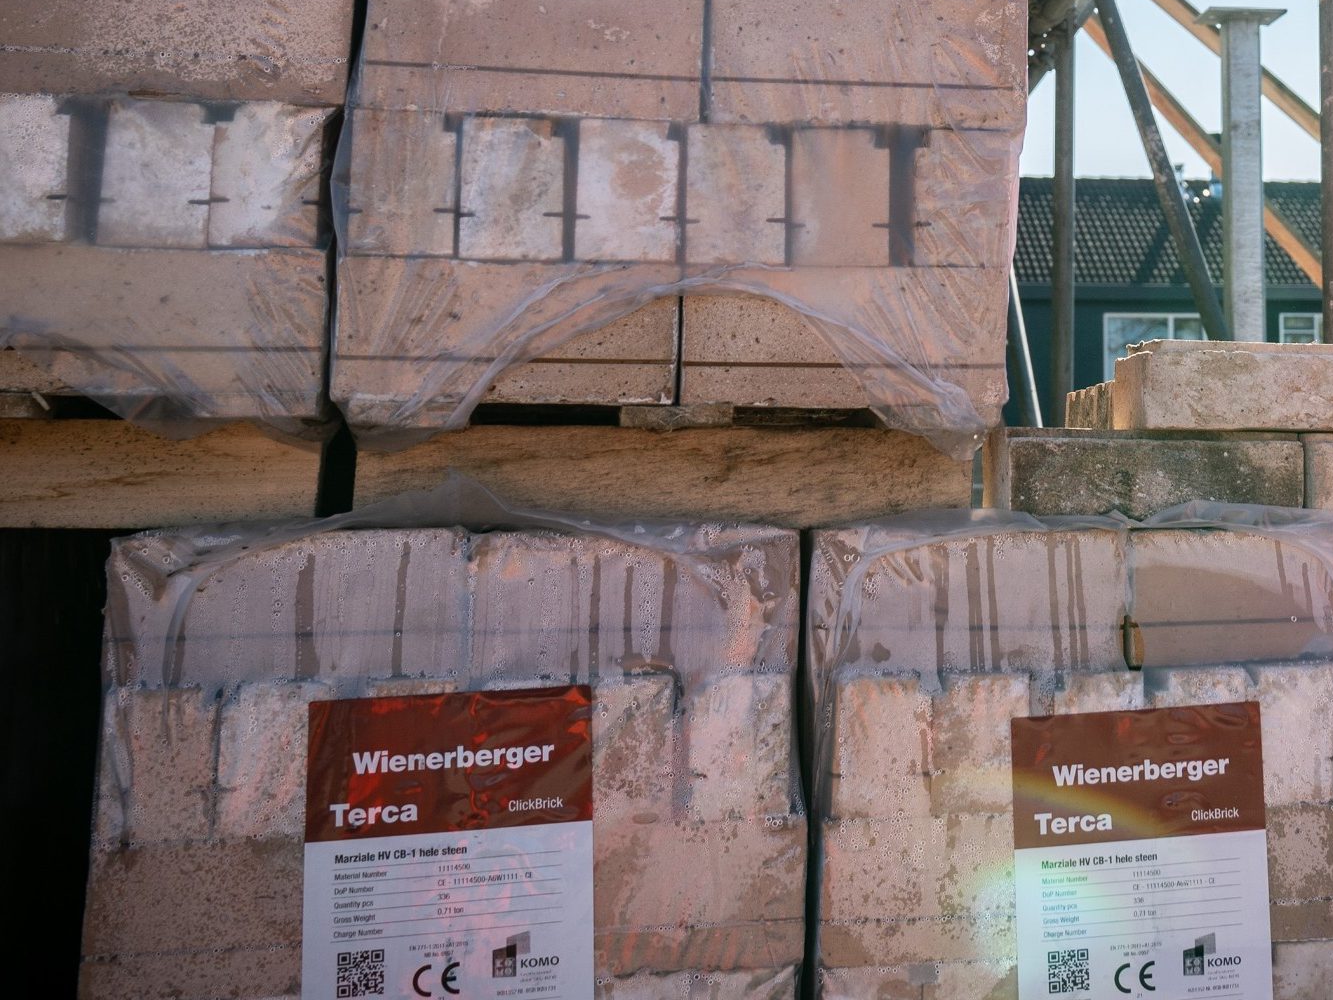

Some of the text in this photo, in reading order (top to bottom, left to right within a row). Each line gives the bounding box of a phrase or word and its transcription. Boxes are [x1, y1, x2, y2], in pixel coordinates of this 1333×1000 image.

[352, 744, 555, 775] Wienerberger
[1052, 757, 1230, 787] Wienerberger
[508, 796, 563, 812] ClickBrick
[330, 803, 418, 828] Terca
[1191, 806, 1240, 822] ClickBrick
[1034, 812, 1112, 836] Terca
[334, 845, 468, 864] Marziale HV CB-1 hele steen
[1041, 853, 1158, 870] Marziale HV CB-1 hele steen
[438, 863, 471, 873] 11114500
[334, 870, 387, 881] Material Number
[1042, 875, 1088, 885] Material Number
[348, 885, 374, 894] Number
[1055, 889, 1077, 897] Number
[333, 900, 361, 910] Quantity
[453, 906, 464, 914] ton
[1042, 903, 1066, 913] Quantity
[333, 914, 376, 925] Gross Weight
[1060, 915, 1080, 924] Weight
[333, 928, 383, 939] Charge Number
[1043, 928, 1087, 938] Charge Number
[520, 955, 560, 969] KOMO
[1207, 955, 1242, 968] KOMO
